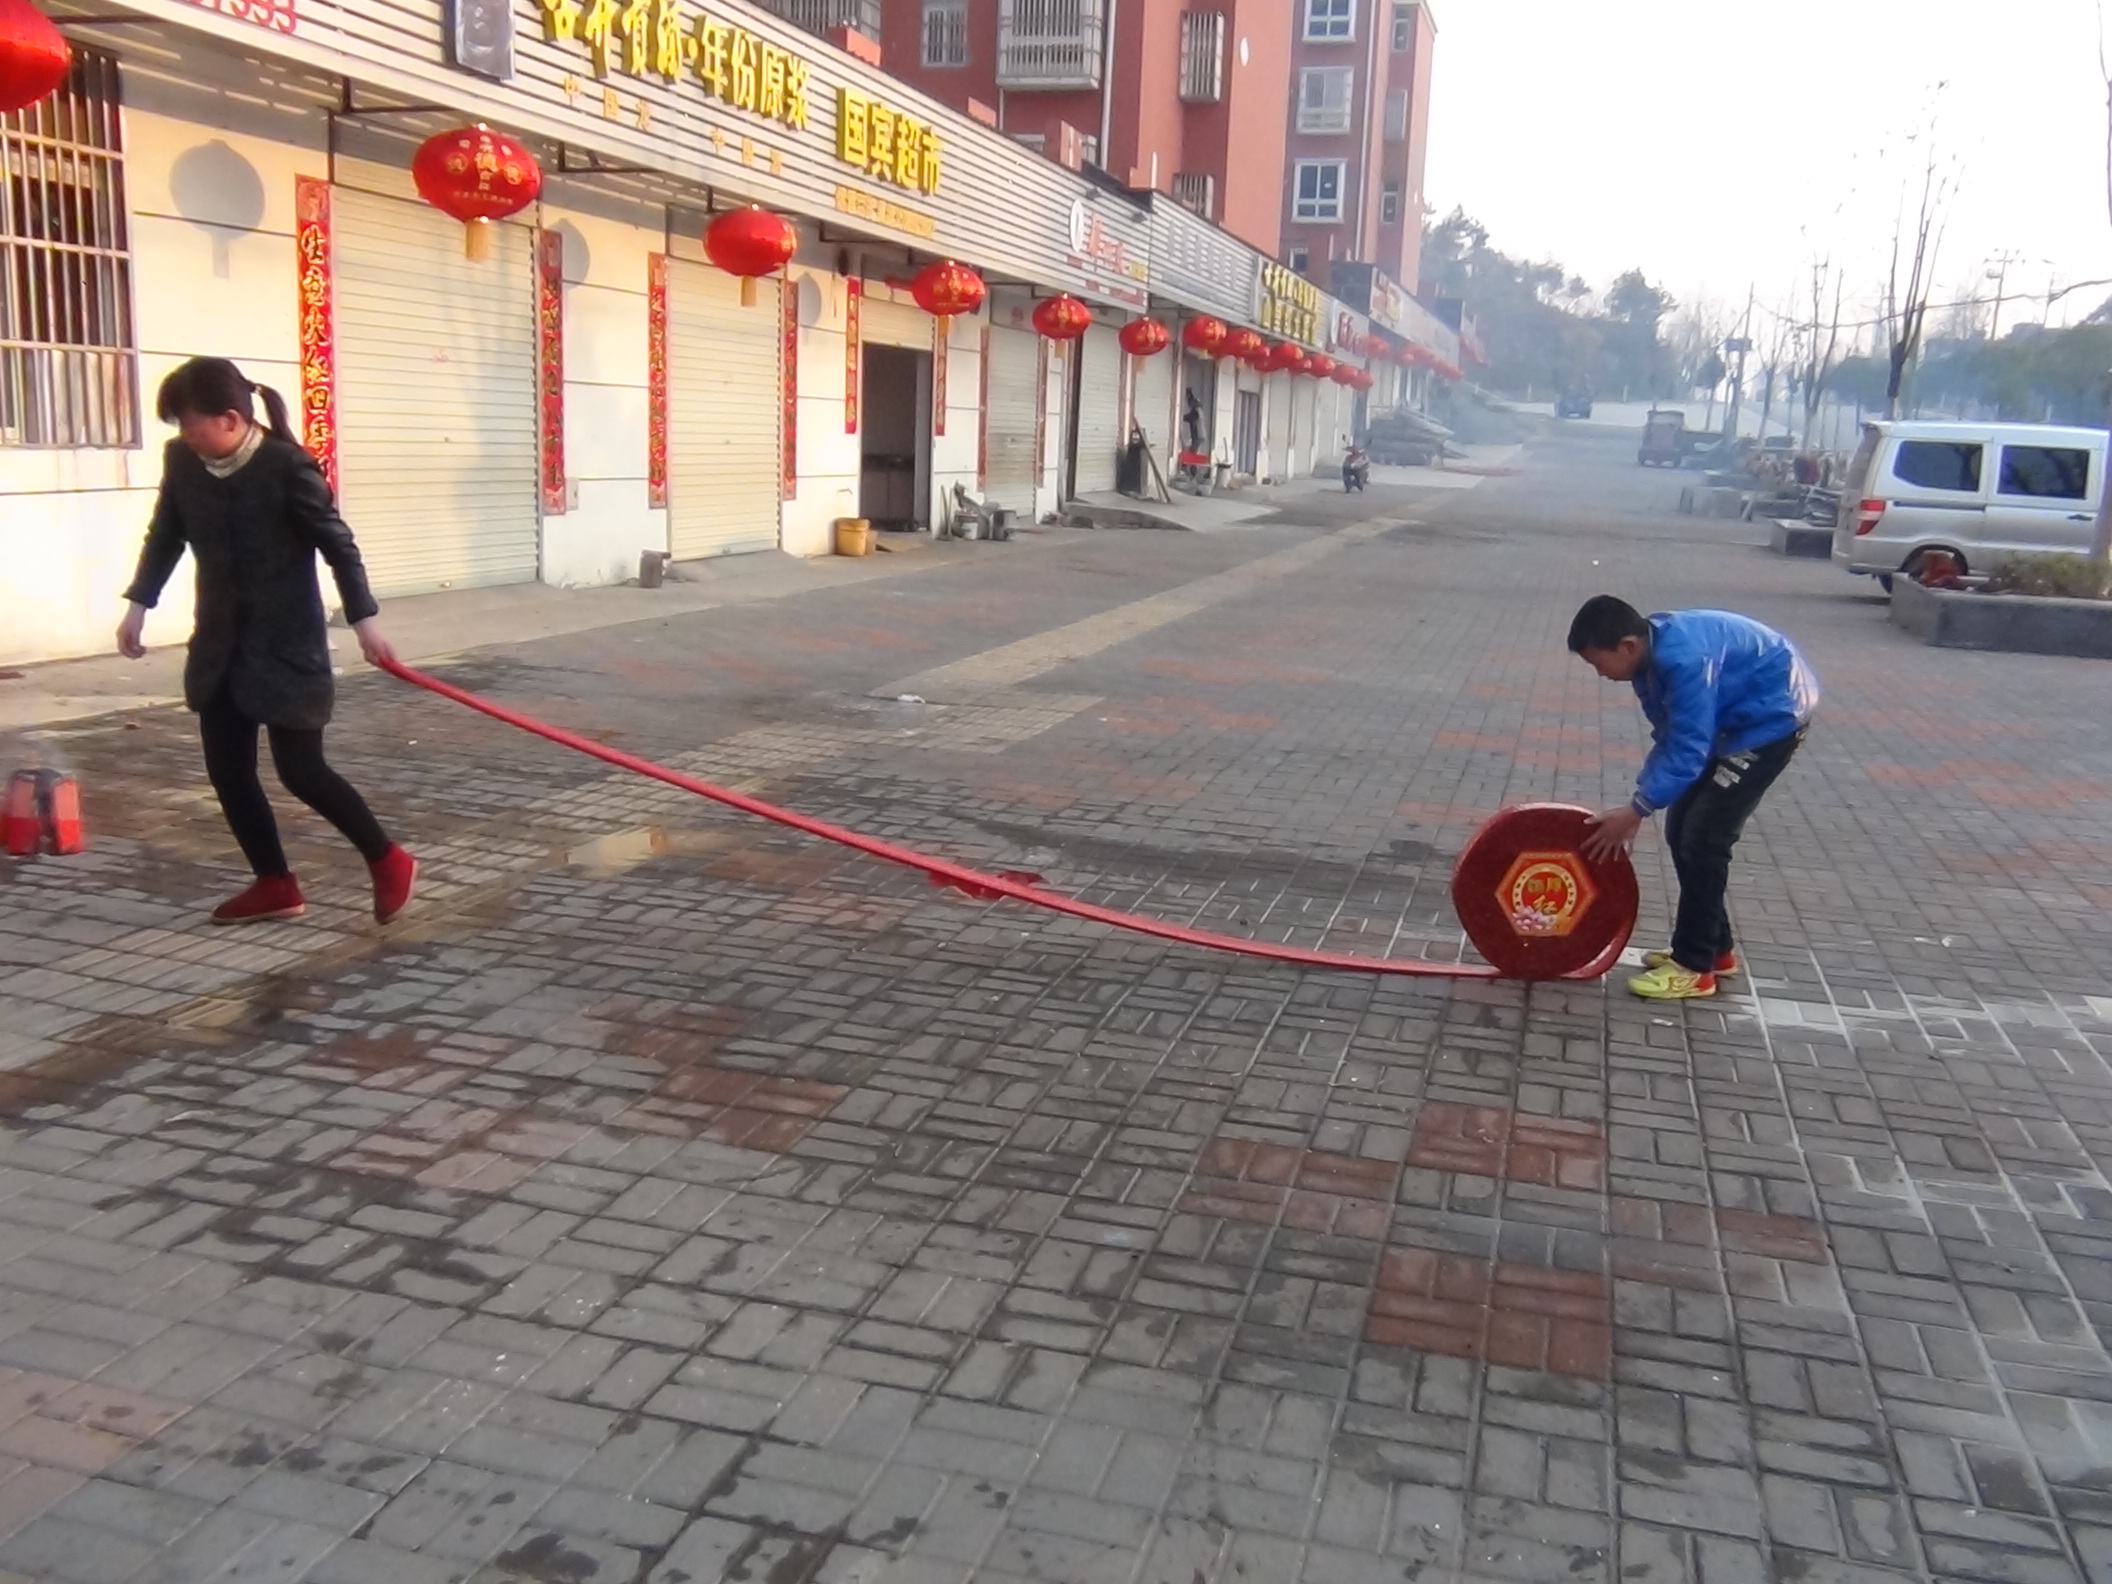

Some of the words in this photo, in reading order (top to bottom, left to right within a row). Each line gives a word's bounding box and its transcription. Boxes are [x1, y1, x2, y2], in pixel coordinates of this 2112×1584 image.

[838, 87, 943, 195] 国宾超市
[300, 222, 336, 487] 生意火红四季
